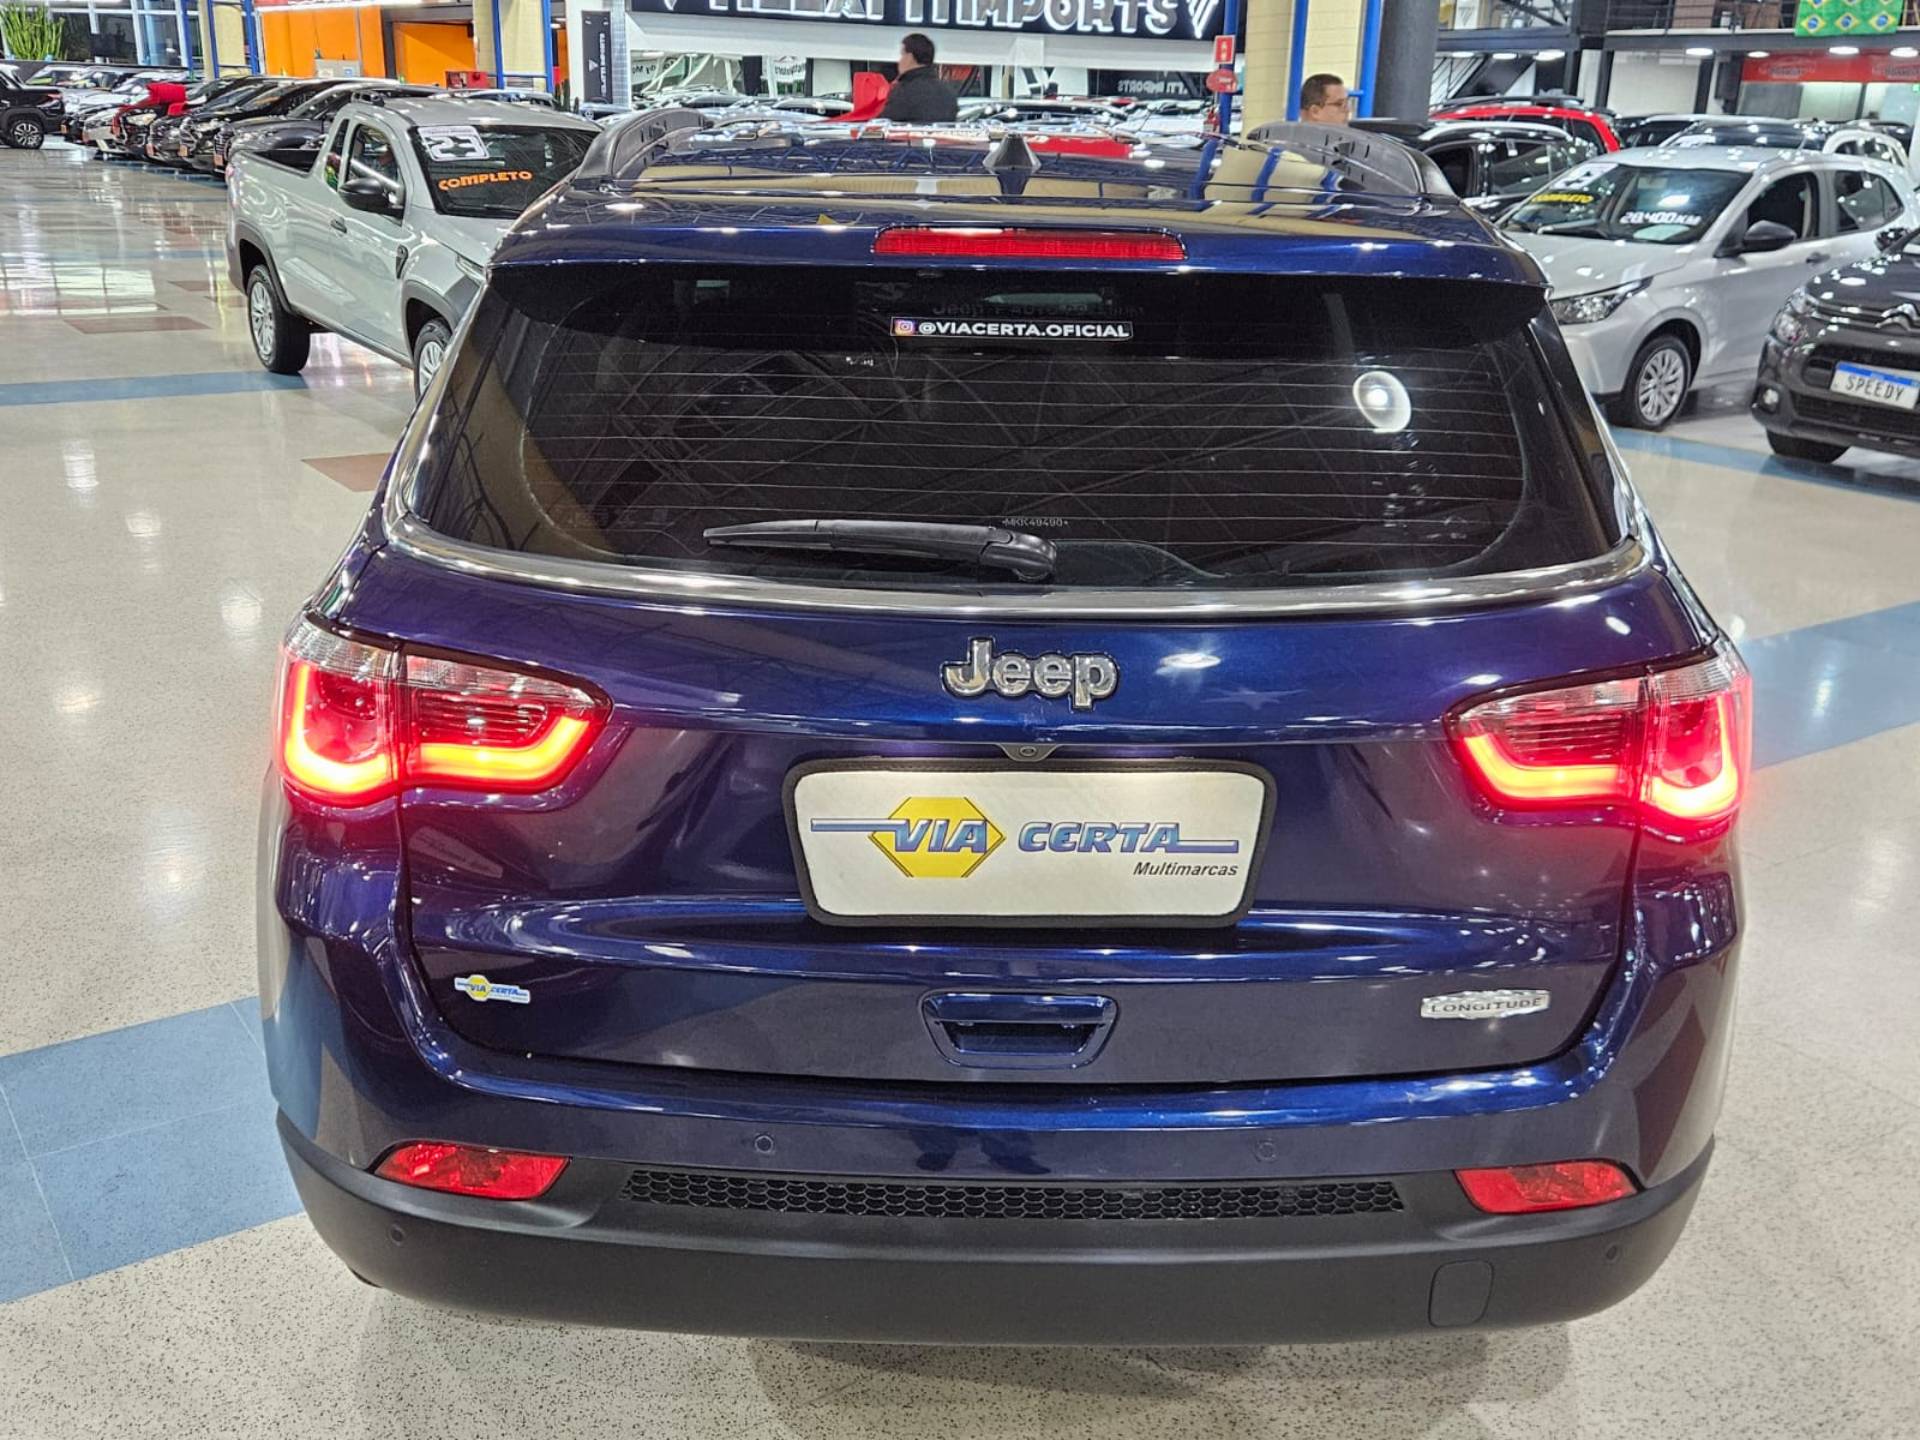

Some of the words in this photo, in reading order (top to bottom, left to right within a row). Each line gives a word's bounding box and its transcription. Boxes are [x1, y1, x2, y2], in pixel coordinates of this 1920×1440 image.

[424, 136, 486, 158] 23
[438, 170, 533, 191] COMPLETO
[918, 321, 1130, 338] @VIACERTA.OFICIAL
[1845, 375, 1905, 402] SPEEDY
[944, 638, 1118, 708] Jeep
[894, 818, 988, 853] VIA
[1017, 821, 1180, 853] CERTA
[1132, 861, 1239, 877] Multimarcas
[1431, 998, 1544, 1013] LONGITUDE
